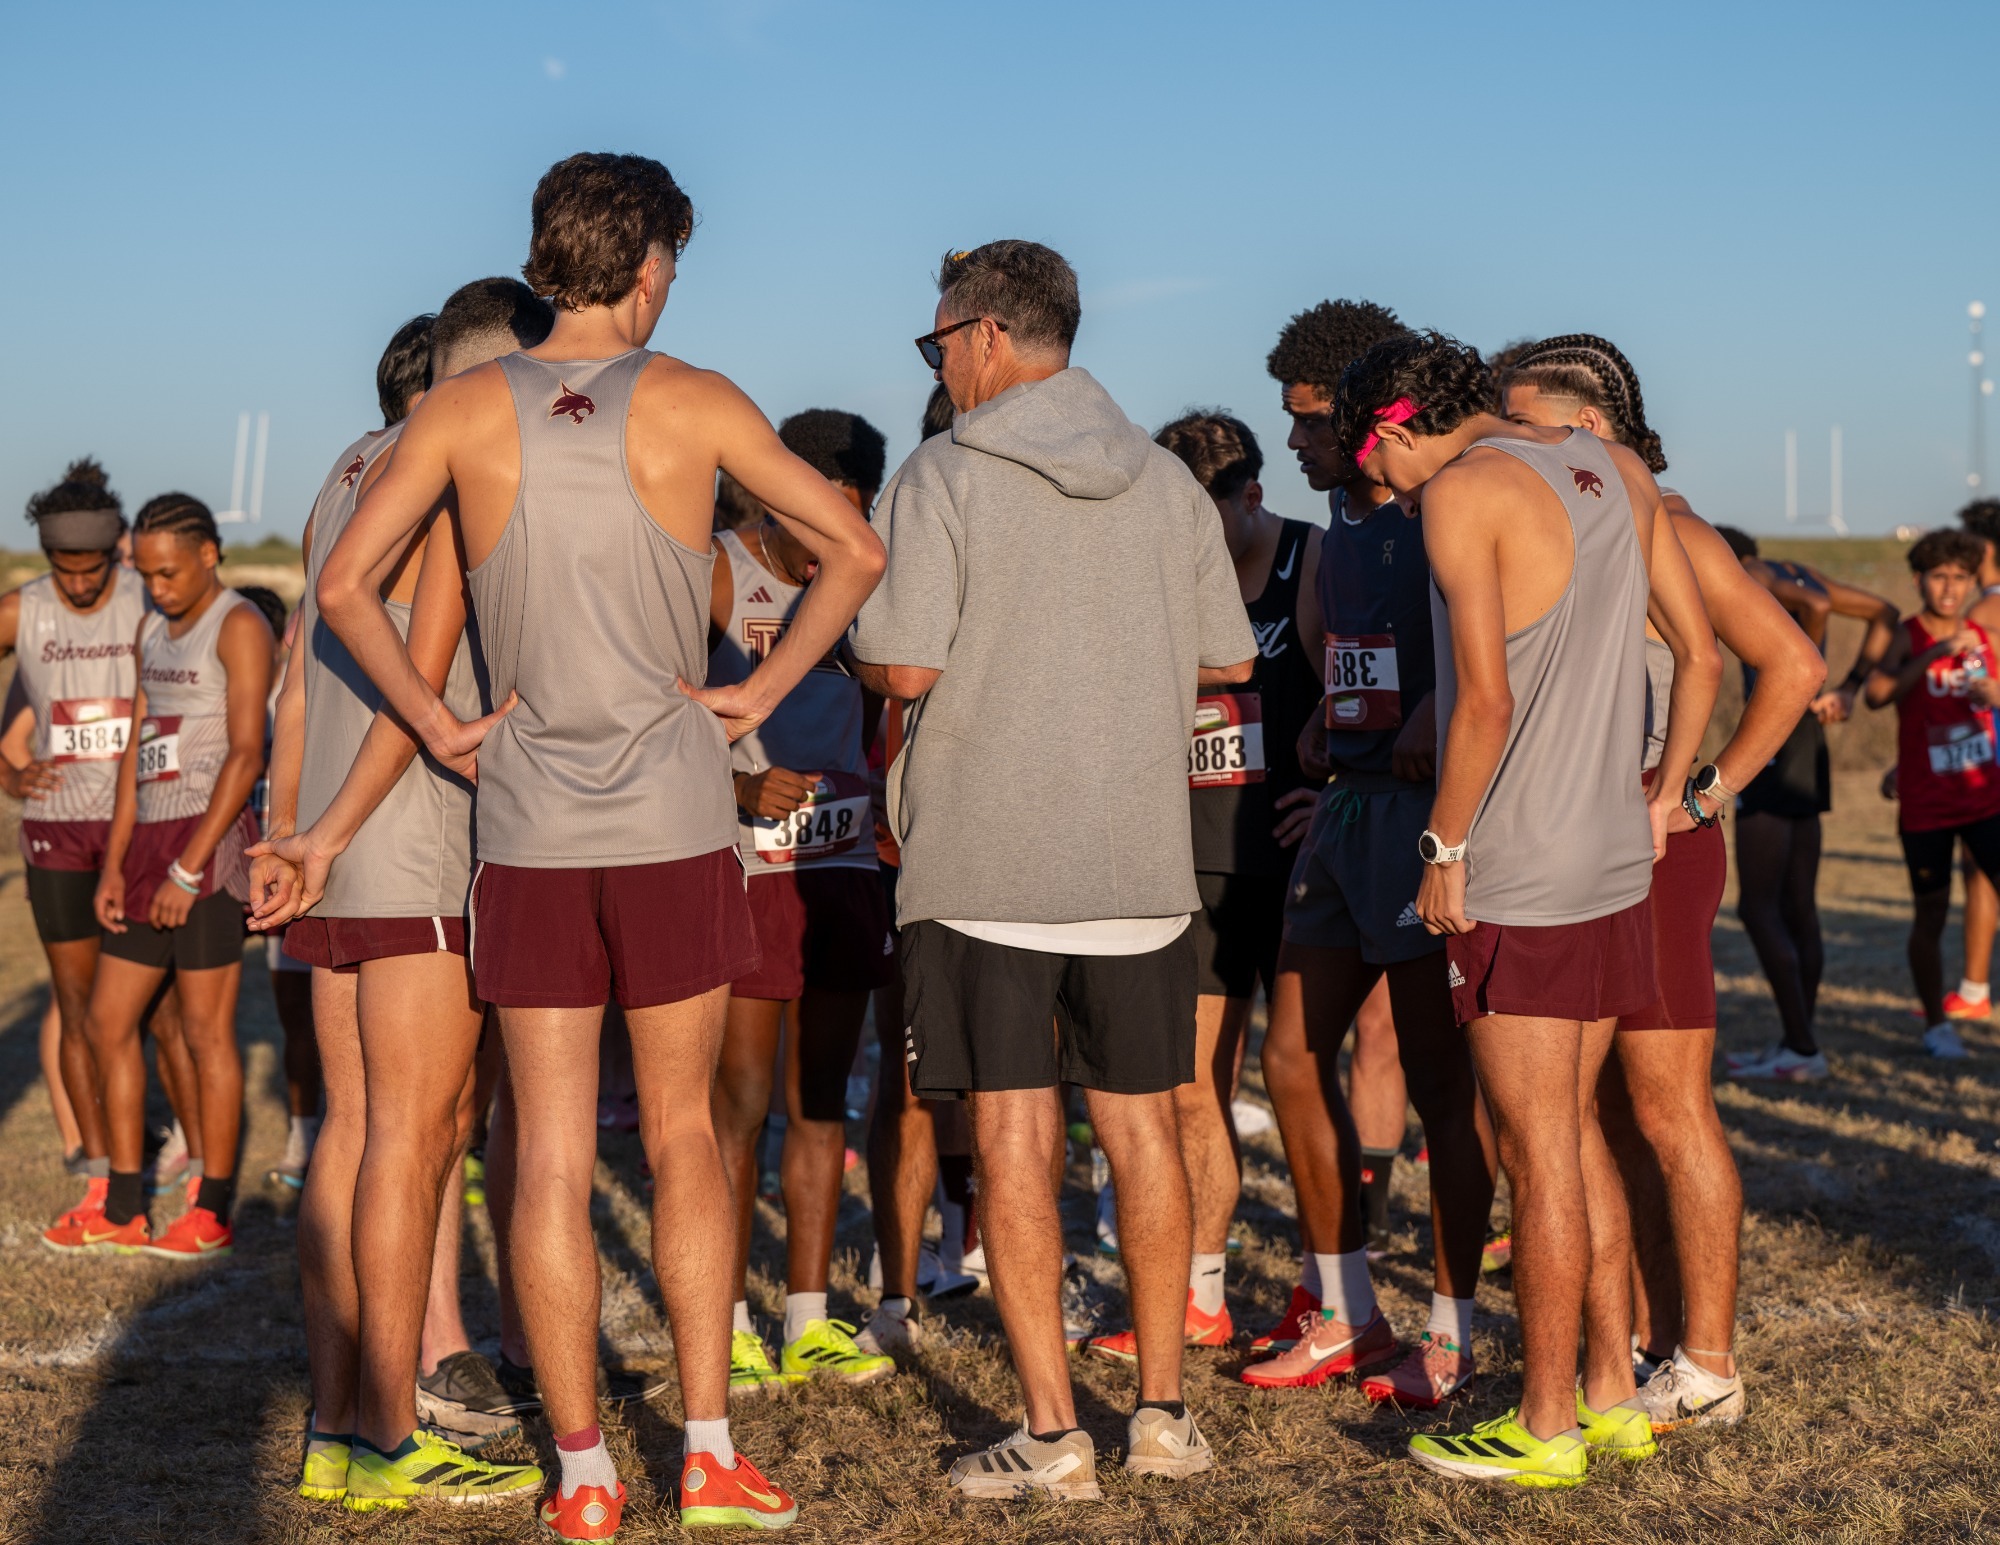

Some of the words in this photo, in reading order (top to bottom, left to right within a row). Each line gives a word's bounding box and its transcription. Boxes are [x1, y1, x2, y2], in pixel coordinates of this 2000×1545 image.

[40, 638, 136, 664] Schreiner
[141, 659, 200, 685] chreiner
[64, 726, 123, 752] 3684
[138, 743, 168, 773] 686
[774, 807, 853, 847] 3848
